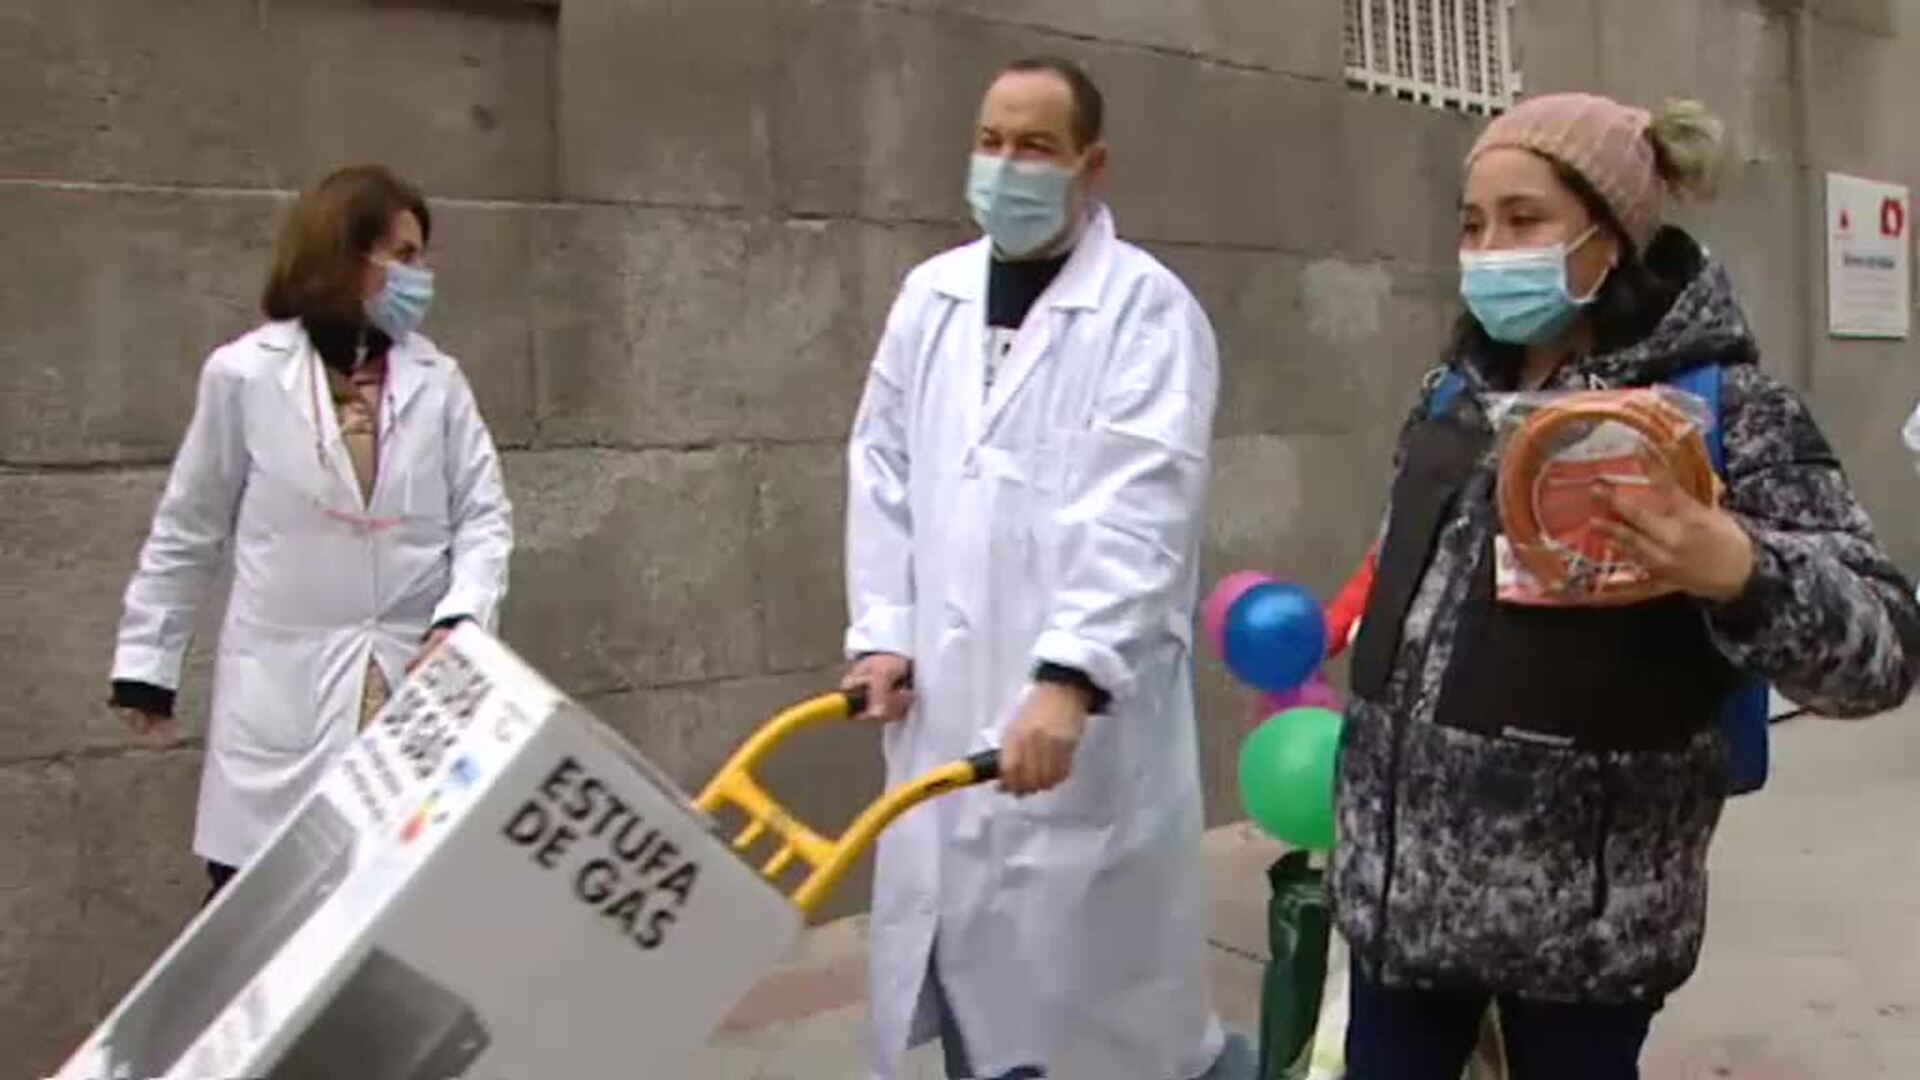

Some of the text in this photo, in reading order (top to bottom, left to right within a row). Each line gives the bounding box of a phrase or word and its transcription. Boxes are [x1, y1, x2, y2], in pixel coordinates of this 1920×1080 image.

[503, 801, 675, 949] DE GAS
[541, 756, 700, 905] ESTUFA
